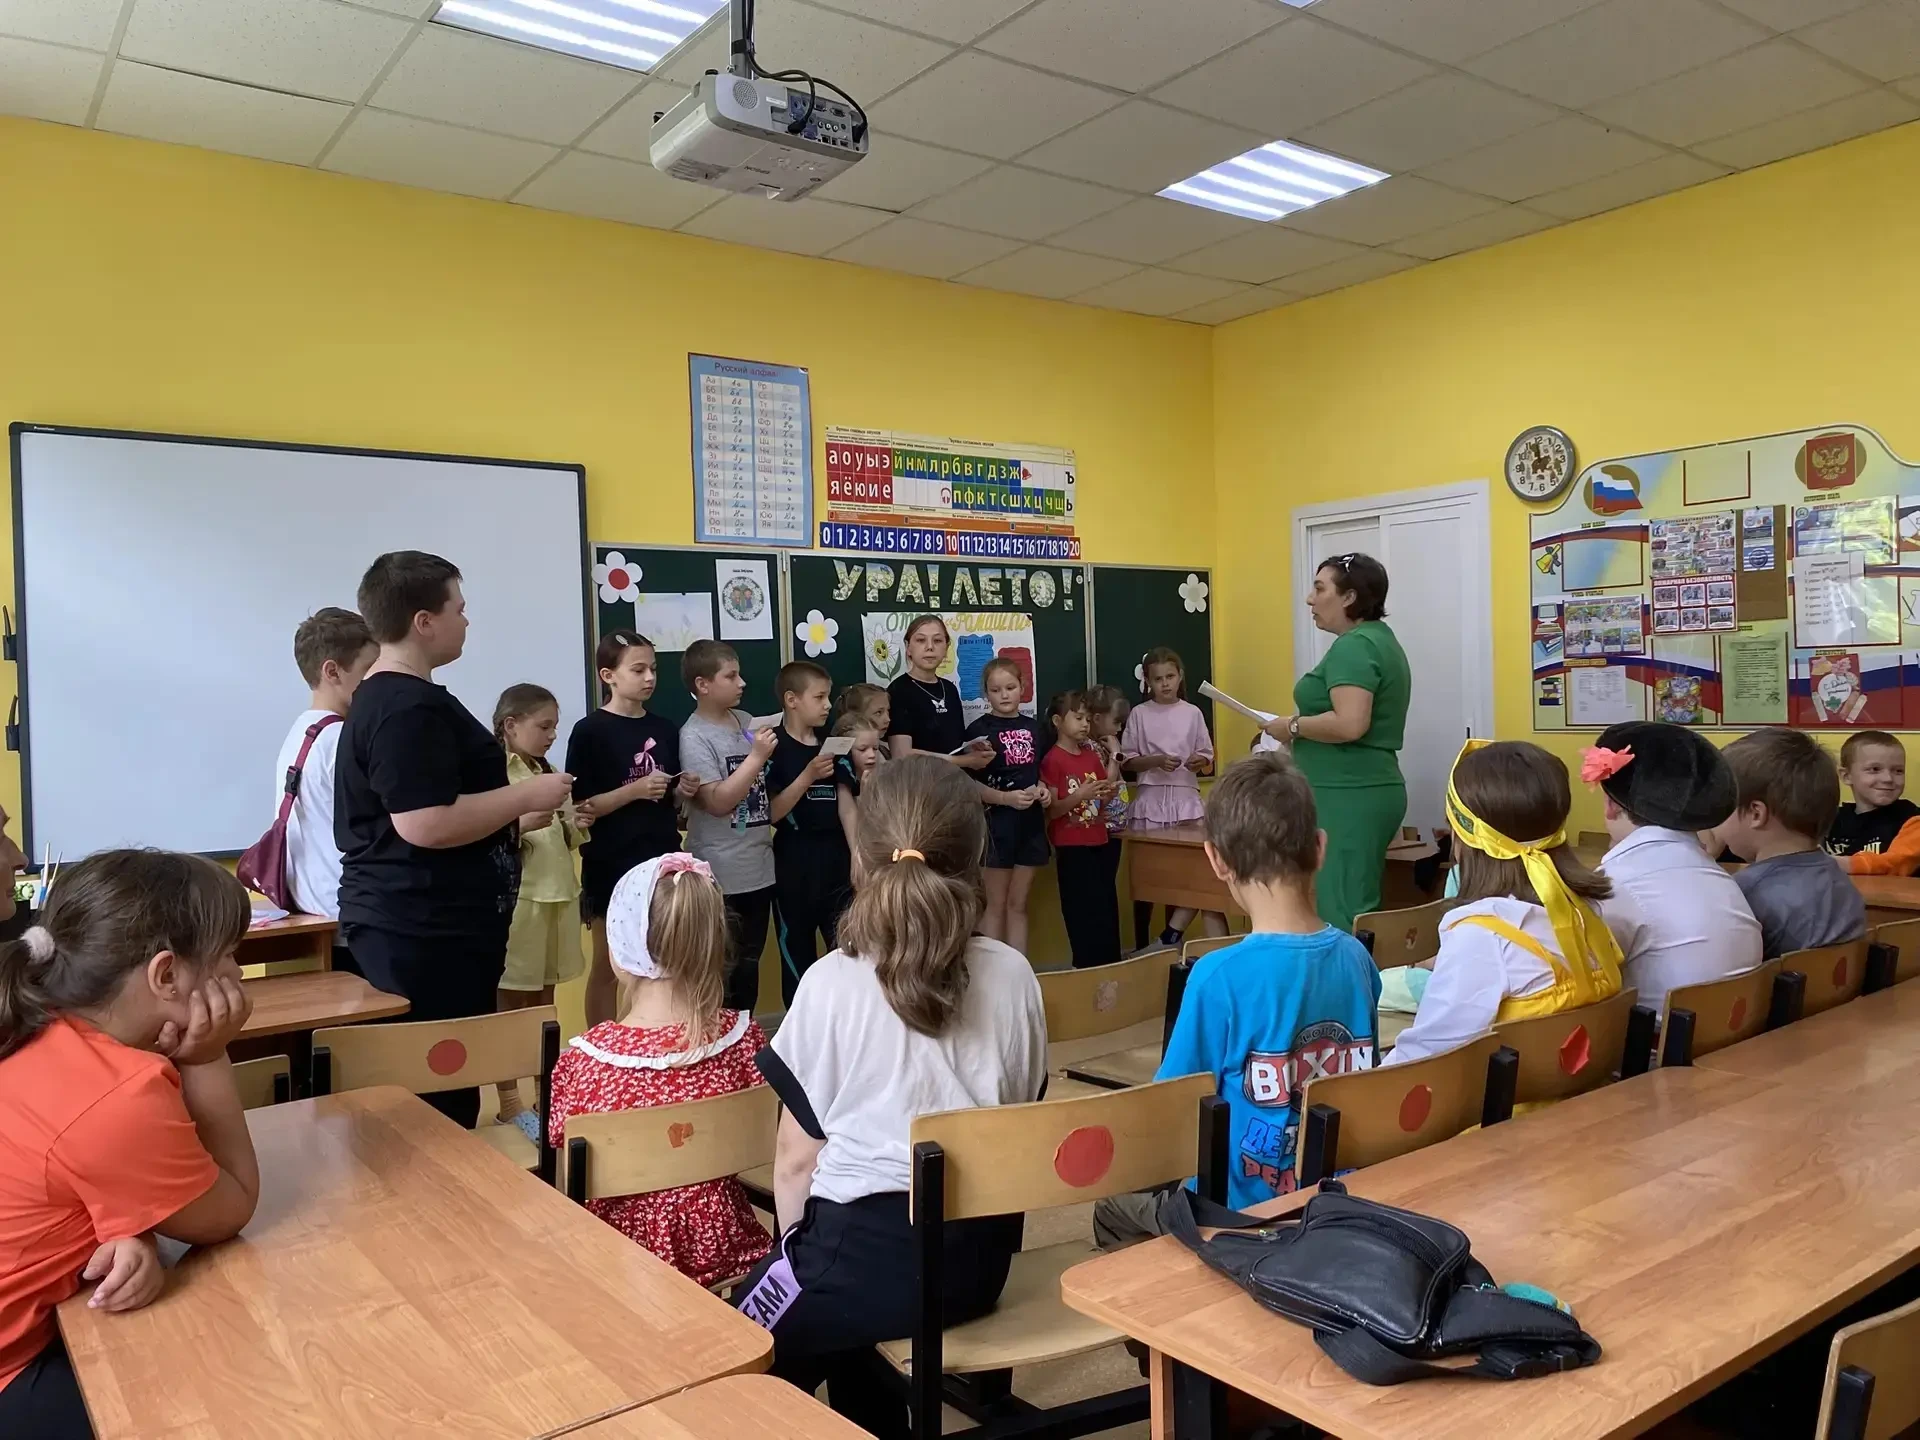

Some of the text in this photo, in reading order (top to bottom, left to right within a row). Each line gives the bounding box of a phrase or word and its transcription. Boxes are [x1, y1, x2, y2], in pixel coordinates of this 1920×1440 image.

[715, 362, 748, 374] Русский
[1534, 436, 1543, 444] 12
[1547, 437, 1552, 445] 1
[1555, 444, 1561, 453] 2
[1515, 454, 1566, 473] 9 3
[1520, 476, 1526, 484] 8
[1528, 482, 1534, 491] 7
[1539, 483, 1545, 491] 6
[822, 527, 1080, 557] 0 1 2 3 4 5 6 7 8 9 10 11 12 13 14 15 16 17 18 19 20
[832, 559, 1074, 611] УРА! ЛЕТО!
[629, 766, 644, 777] JUST
